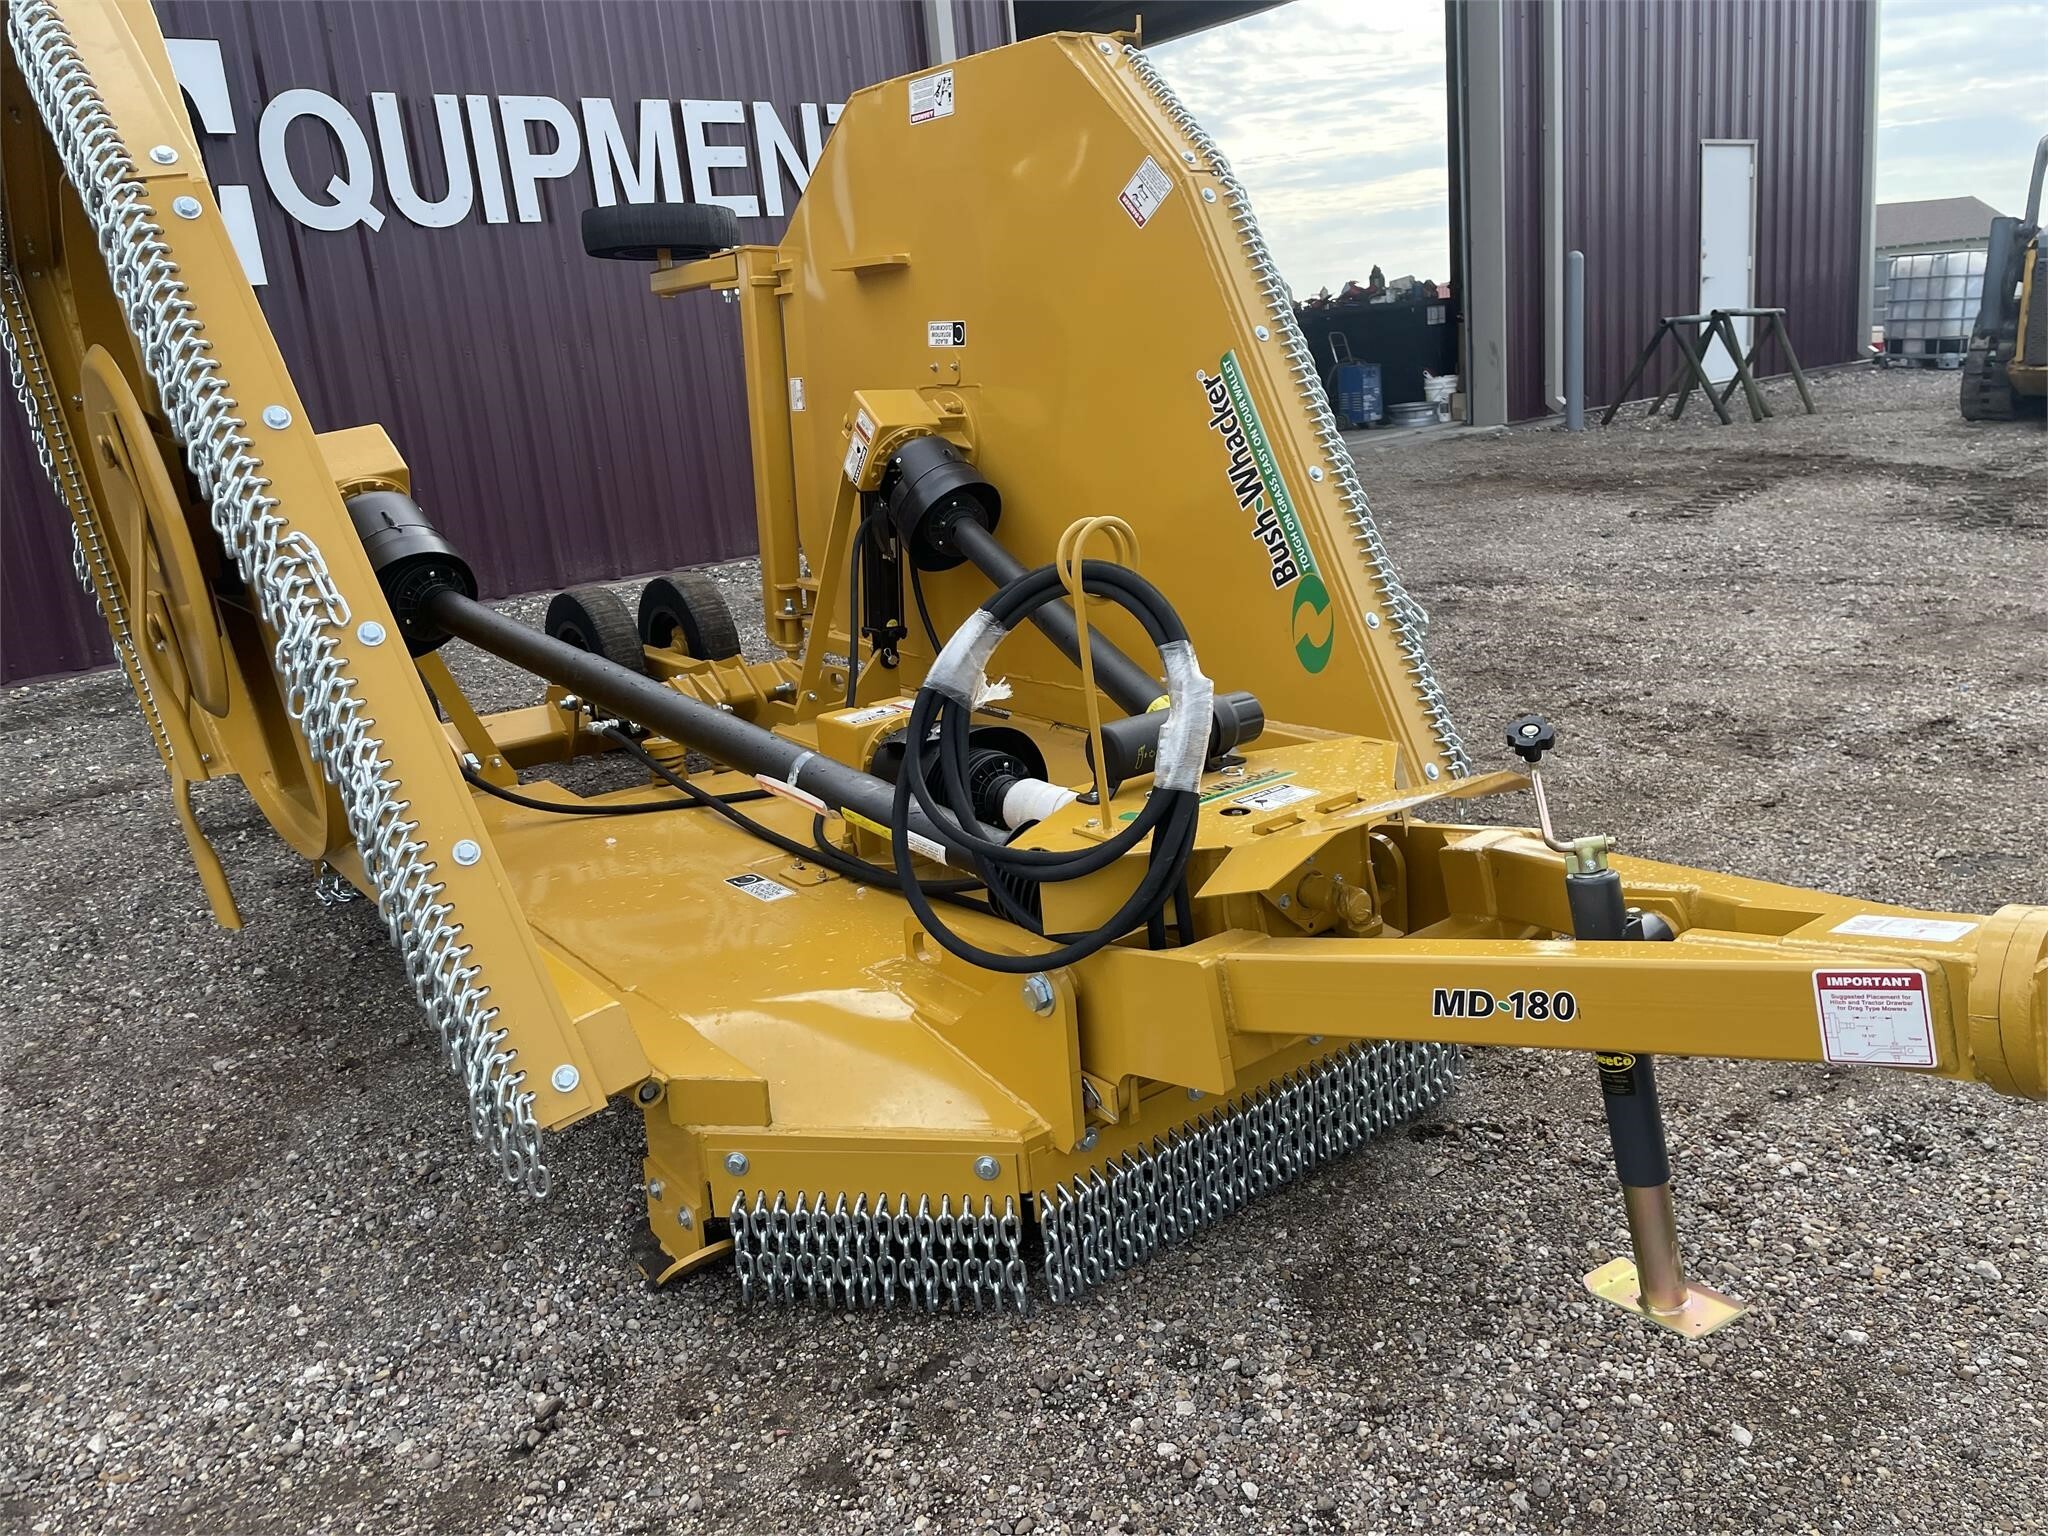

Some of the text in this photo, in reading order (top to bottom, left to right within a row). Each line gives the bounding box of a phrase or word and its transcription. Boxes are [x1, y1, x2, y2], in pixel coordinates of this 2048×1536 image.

[1223, 360, 1310, 571] TOUGH ON GRASS, EASY ON YOUR WALLET
[1826, 976, 1911, 987] IMPORTANT
